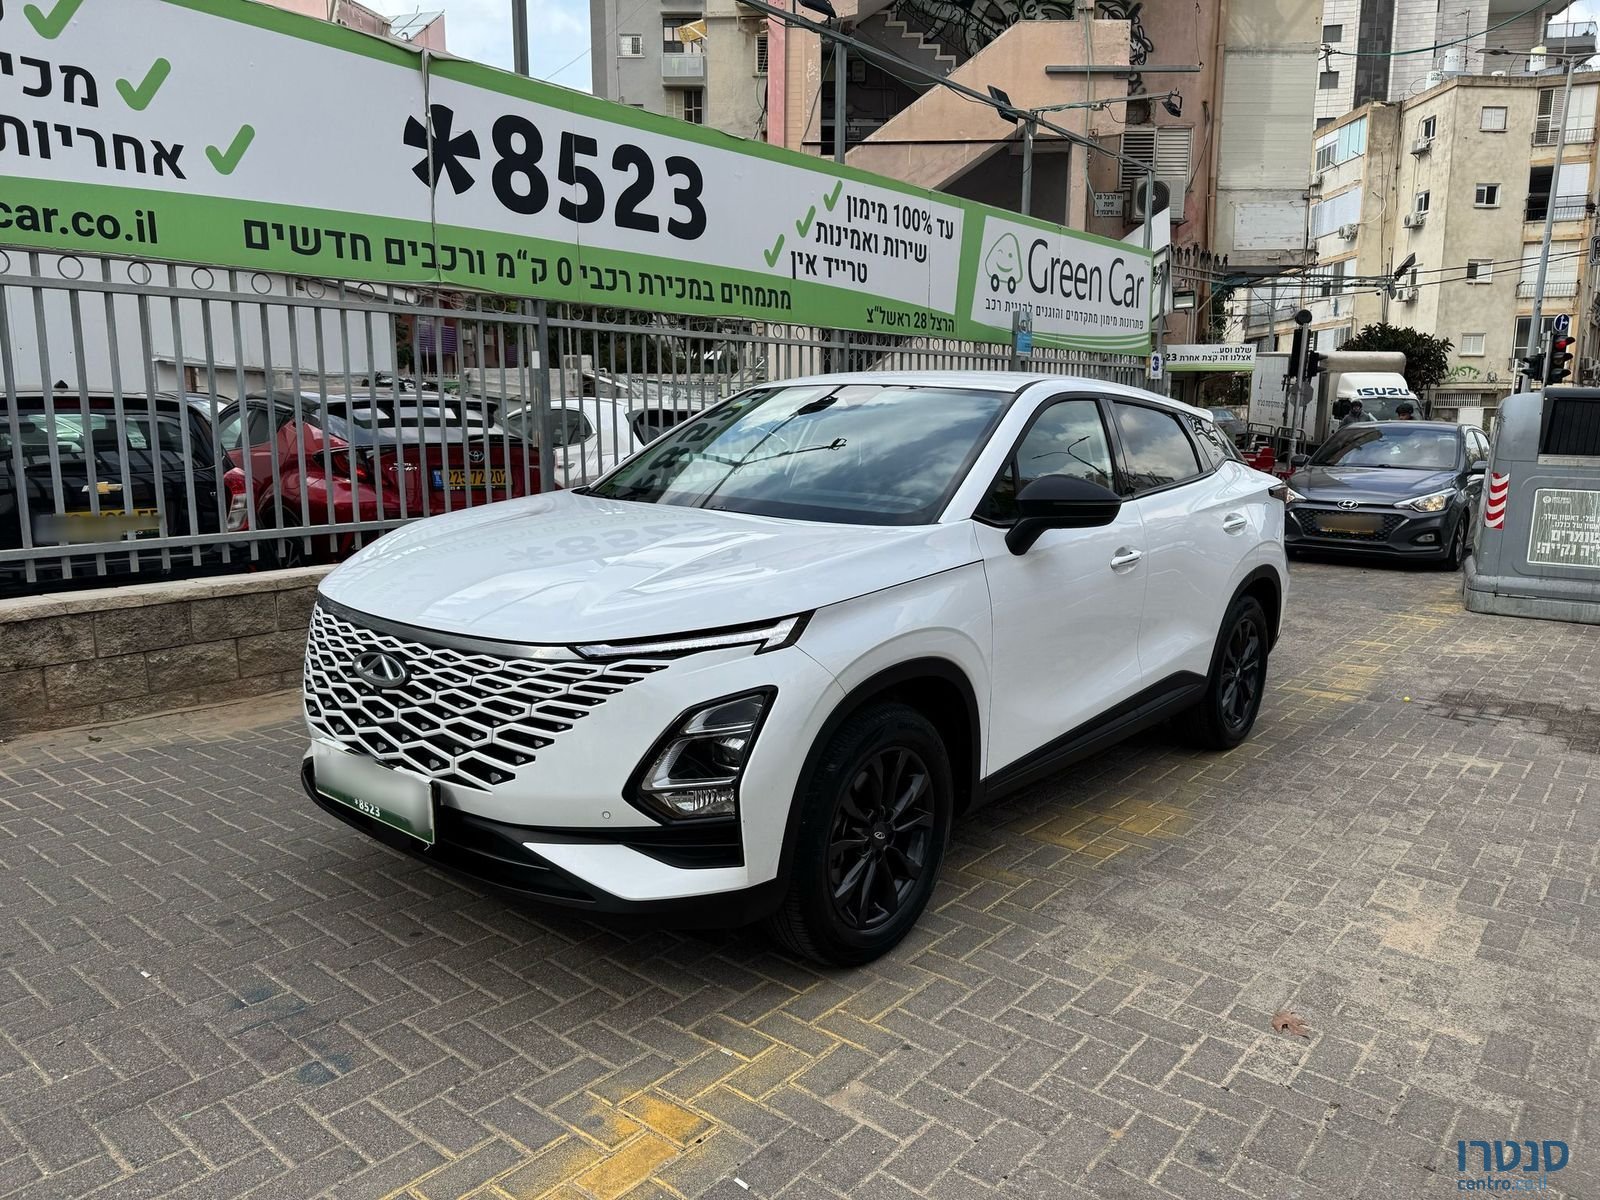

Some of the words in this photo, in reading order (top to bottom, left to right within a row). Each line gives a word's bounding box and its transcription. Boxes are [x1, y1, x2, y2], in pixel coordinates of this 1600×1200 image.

[847, 195, 888, 225] מימון
[894, 204, 933, 235] 100%
[243, 219, 373, 262] חדשים
[816, 221, 879, 254] ואמינות
[937, 218, 954, 240] עד
[385, 236, 486, 276] ורכבים
[883, 236, 927, 263] שירות
[557, 256, 573, 286] 0
[580, 263, 632, 292] רכבי
[790, 250, 818, 280] אין
[823, 256, 868, 284] טרייד
[1028, 238, 1102, 303] Green
[1108, 257, 1145, 309] Car
[638, 270, 715, 302] במכירת
[721, 282, 792, 310] מתמחים
[985, 297, 1002, 311] רכב
[913, 310, 927, 330] 28
[929, 312, 955, 333] הרצל
[1065, 311, 1099, 326] מתקדמים
[1100, 314, 1118, 328] מימון
[1119, 318, 1145, 330] פתרונות
[1358, 388, 1410, 396] ISUZU
